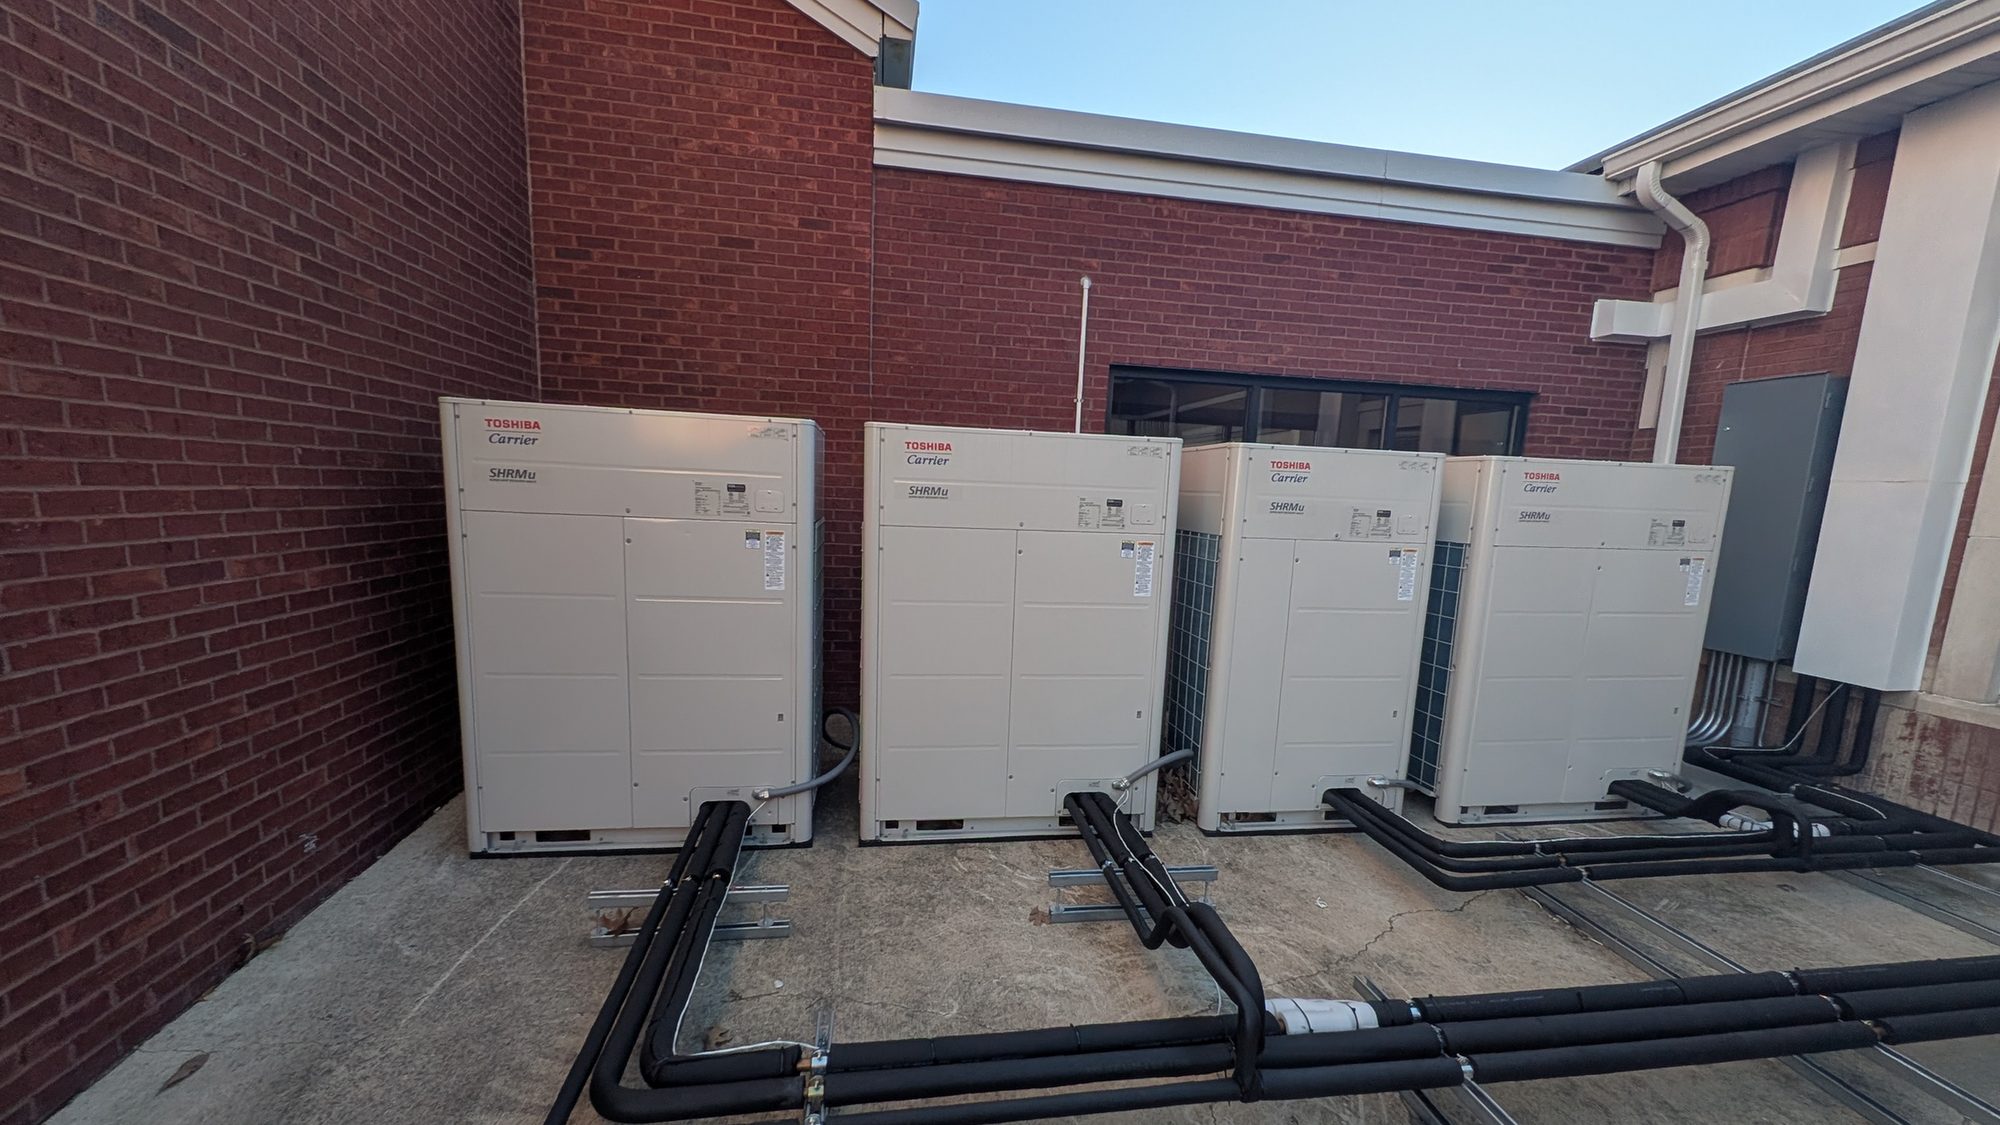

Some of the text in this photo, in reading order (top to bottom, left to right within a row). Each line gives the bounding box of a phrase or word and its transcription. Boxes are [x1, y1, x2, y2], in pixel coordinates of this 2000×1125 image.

[484, 419, 541, 430] TOSHIBA
[489, 433, 538, 445] Carrier
[905, 442, 952, 451] TOSHIBA
[907, 454, 949, 465] Carrier
[1270, 461, 1311, 470] TOSHIBA
[489, 468, 536, 479] SHRMu
[1271, 473, 1308, 483] Carrier
[1524, 472, 1560, 480] TOSHIBA
[908, 486, 948, 496] SHRMu
[1523, 483, 1557, 493] Carrier
[1270, 502, 1304, 511] SHRMu
[1519, 511, 1551, 520] SHRMu
